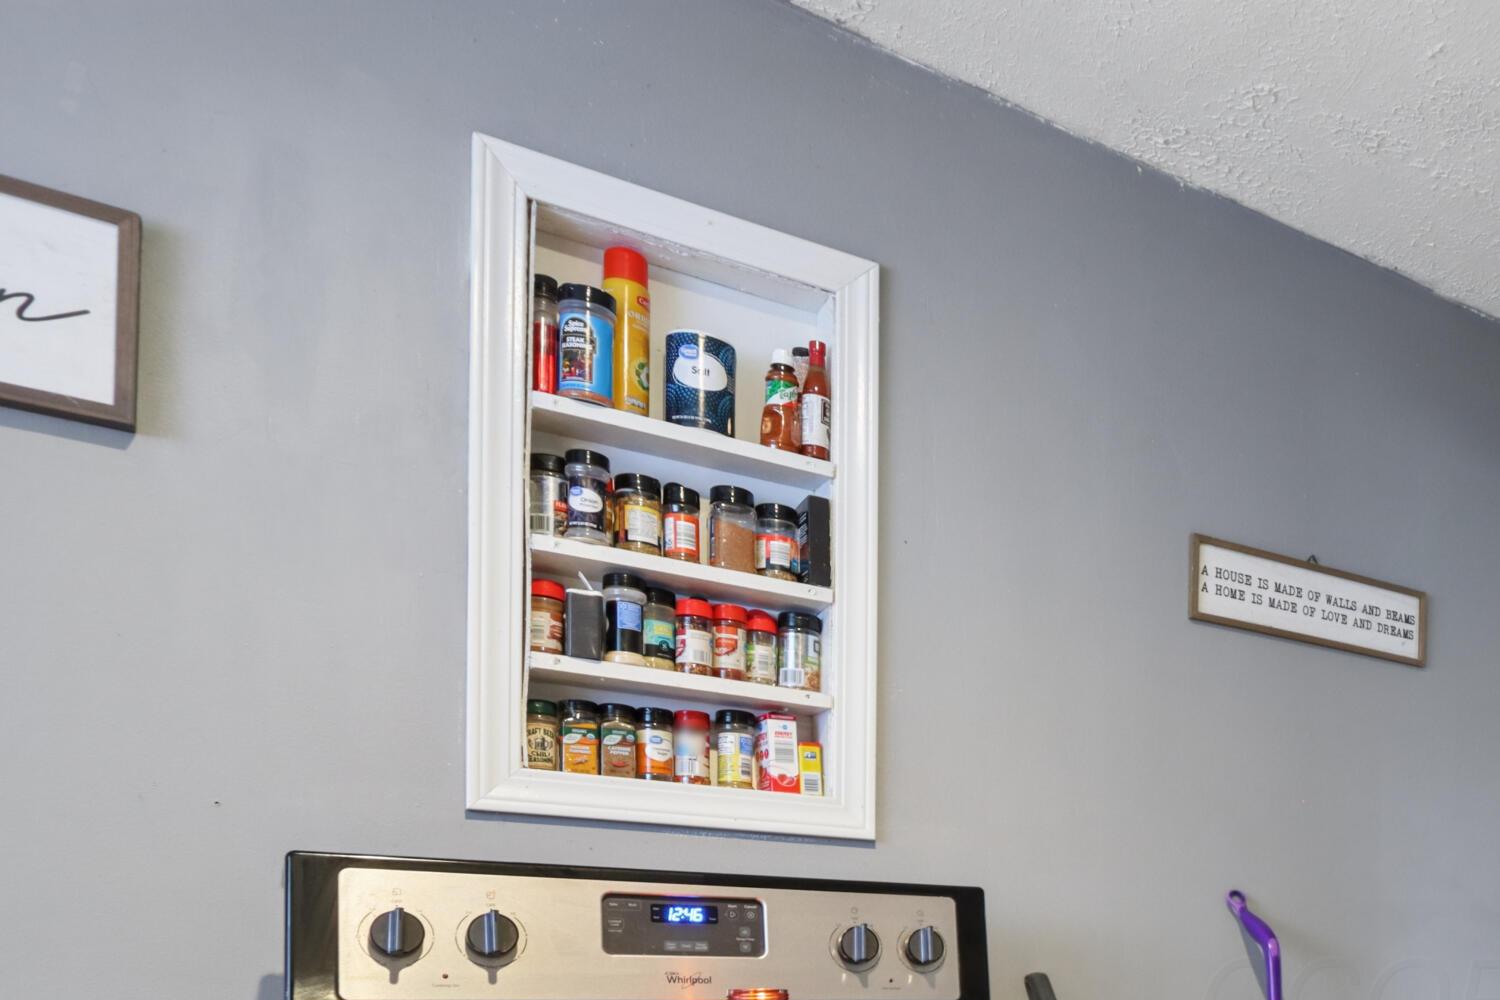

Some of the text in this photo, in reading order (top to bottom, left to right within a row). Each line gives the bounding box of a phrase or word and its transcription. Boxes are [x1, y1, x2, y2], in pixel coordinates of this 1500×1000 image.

[1201, 564, 1416, 625] A HOUSE IS MADE OF WALLS AND BEAMS
[1201, 582, 1414, 640] A HOME IS MADE OF LOVE AND DREAMS
[667, 907, 704, 922] 12:46
[666, 974, 713, 987] Whirlpool
